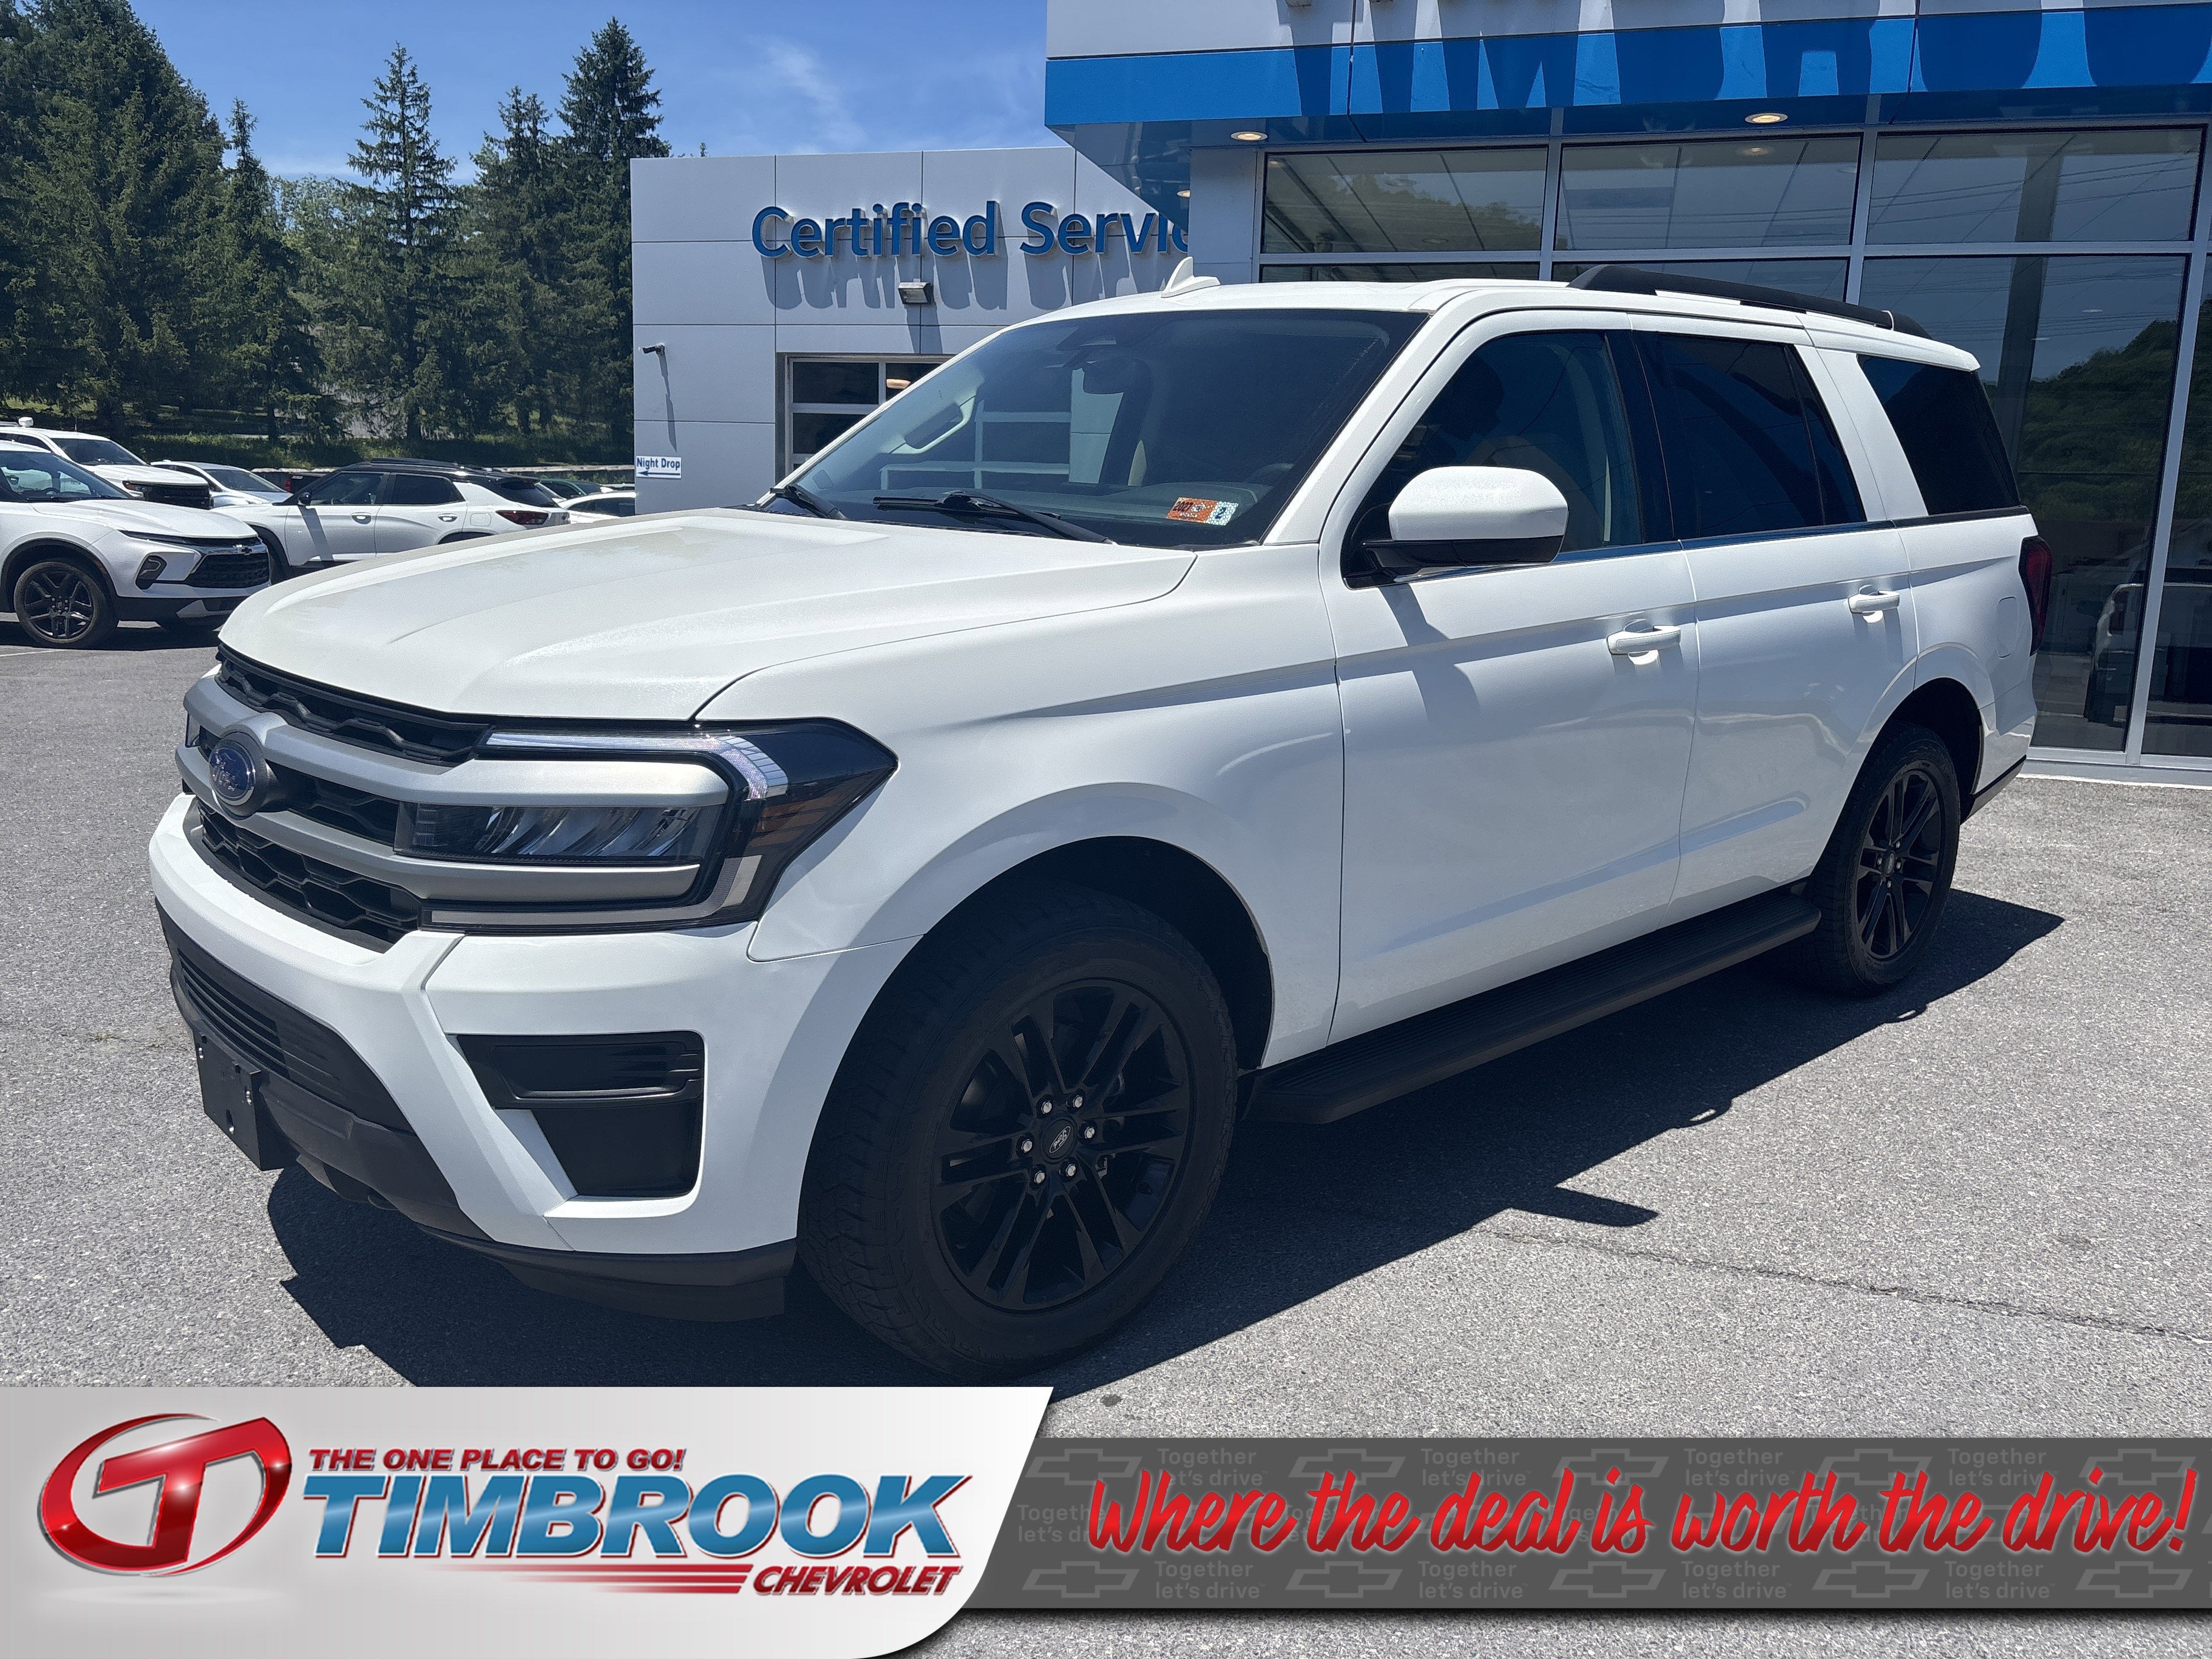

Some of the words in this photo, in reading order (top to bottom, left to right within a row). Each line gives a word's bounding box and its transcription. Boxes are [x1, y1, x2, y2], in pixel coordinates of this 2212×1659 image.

[752, 201, 1000, 257] Certified
[636, 457, 658, 470] Night
[661, 458, 680, 471] Drop
